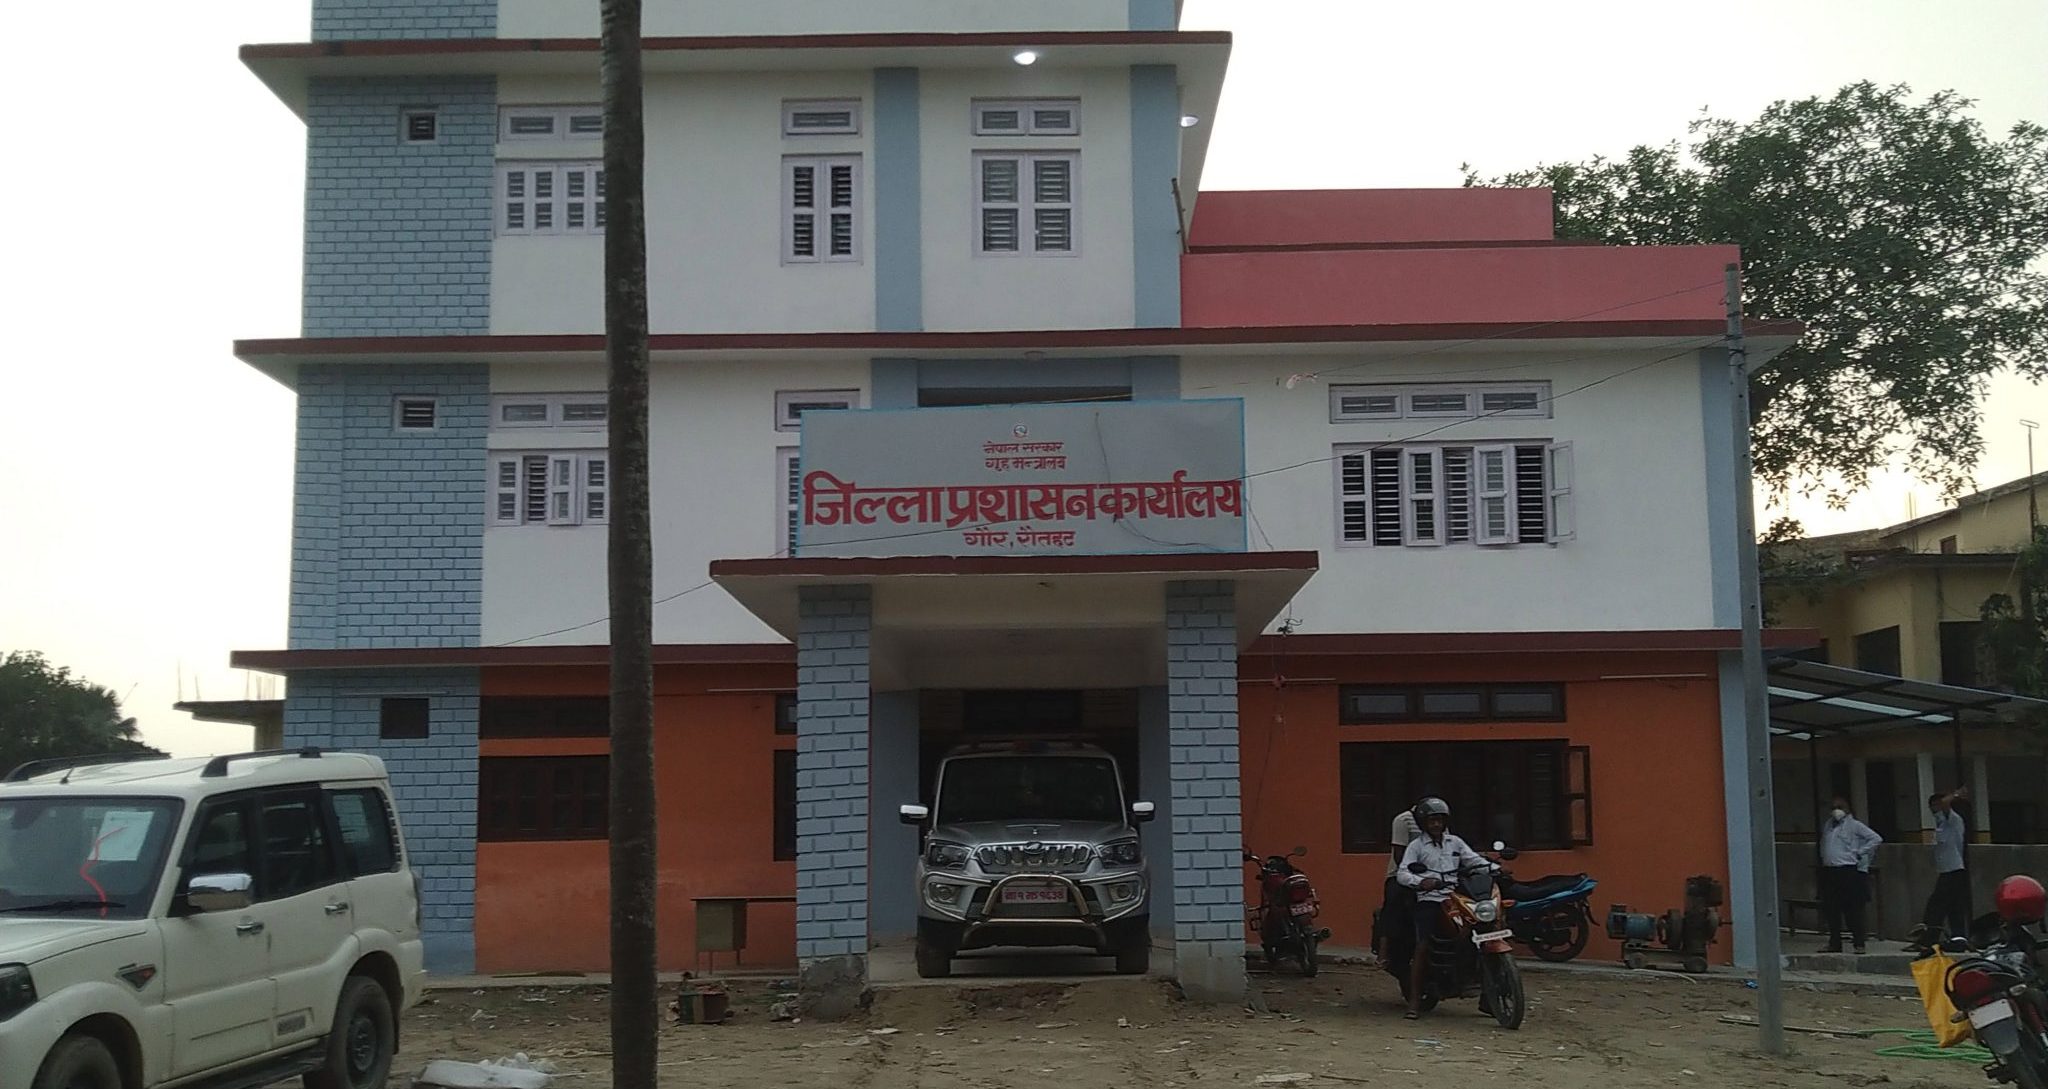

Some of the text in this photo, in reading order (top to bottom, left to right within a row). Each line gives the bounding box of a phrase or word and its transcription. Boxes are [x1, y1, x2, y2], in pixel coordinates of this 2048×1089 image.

[983, 441, 1064, 454] नेपाल सरकार
[985, 456, 1067, 471] गृह मन्त्रालय
[803, 469, 1242, 528] जिल्ला प्रशासन कार्यालय
[963, 526, 1076, 549] गौर, रौतहट
